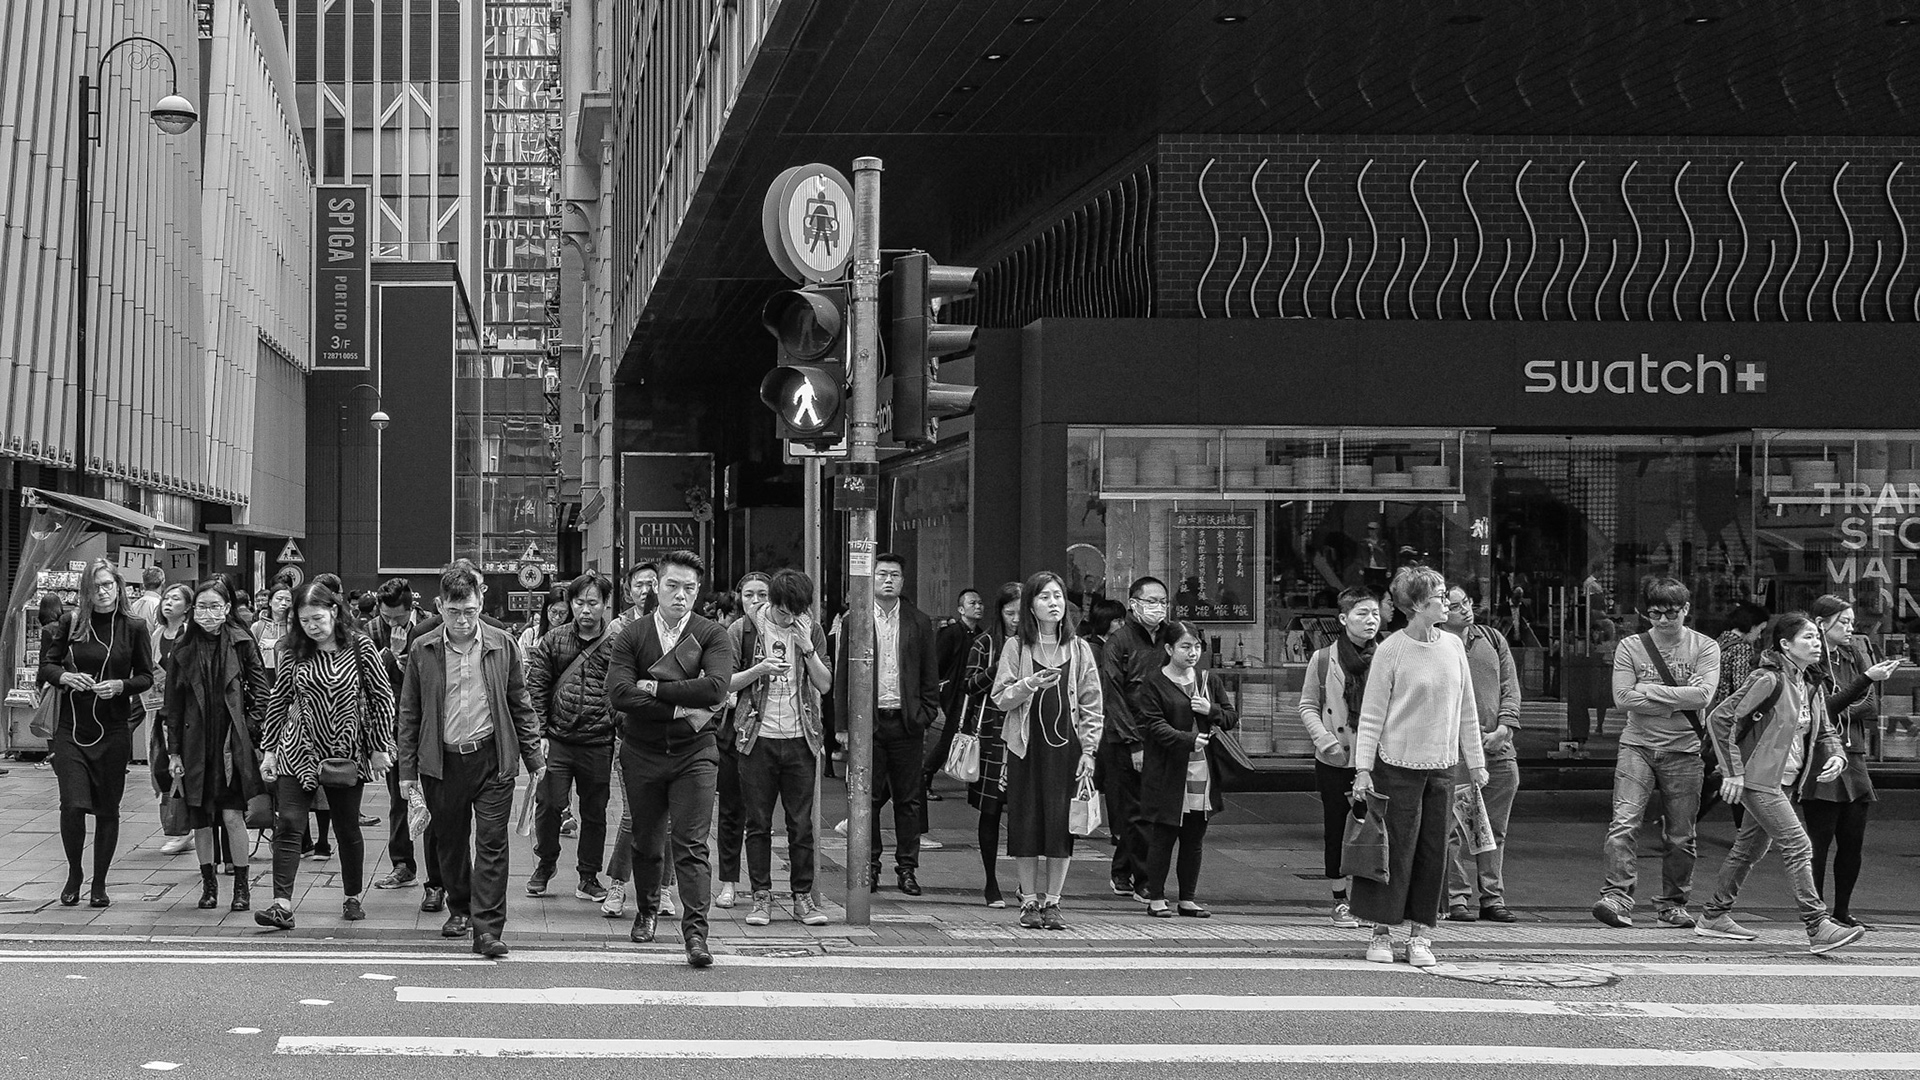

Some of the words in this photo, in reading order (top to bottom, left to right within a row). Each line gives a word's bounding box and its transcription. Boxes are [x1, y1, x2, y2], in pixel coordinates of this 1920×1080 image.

[327, 197, 355, 262] SPIGA
[334, 276, 347, 330] PORTICO
[330, 336, 351, 349] 3/F
[1524, 353, 1728, 395] swatch
[639, 523, 694, 537] CHINA
[640, 537, 695, 546] BUILDING
[123, 551, 147, 569] FT
[171, 553, 195, 569] FT
